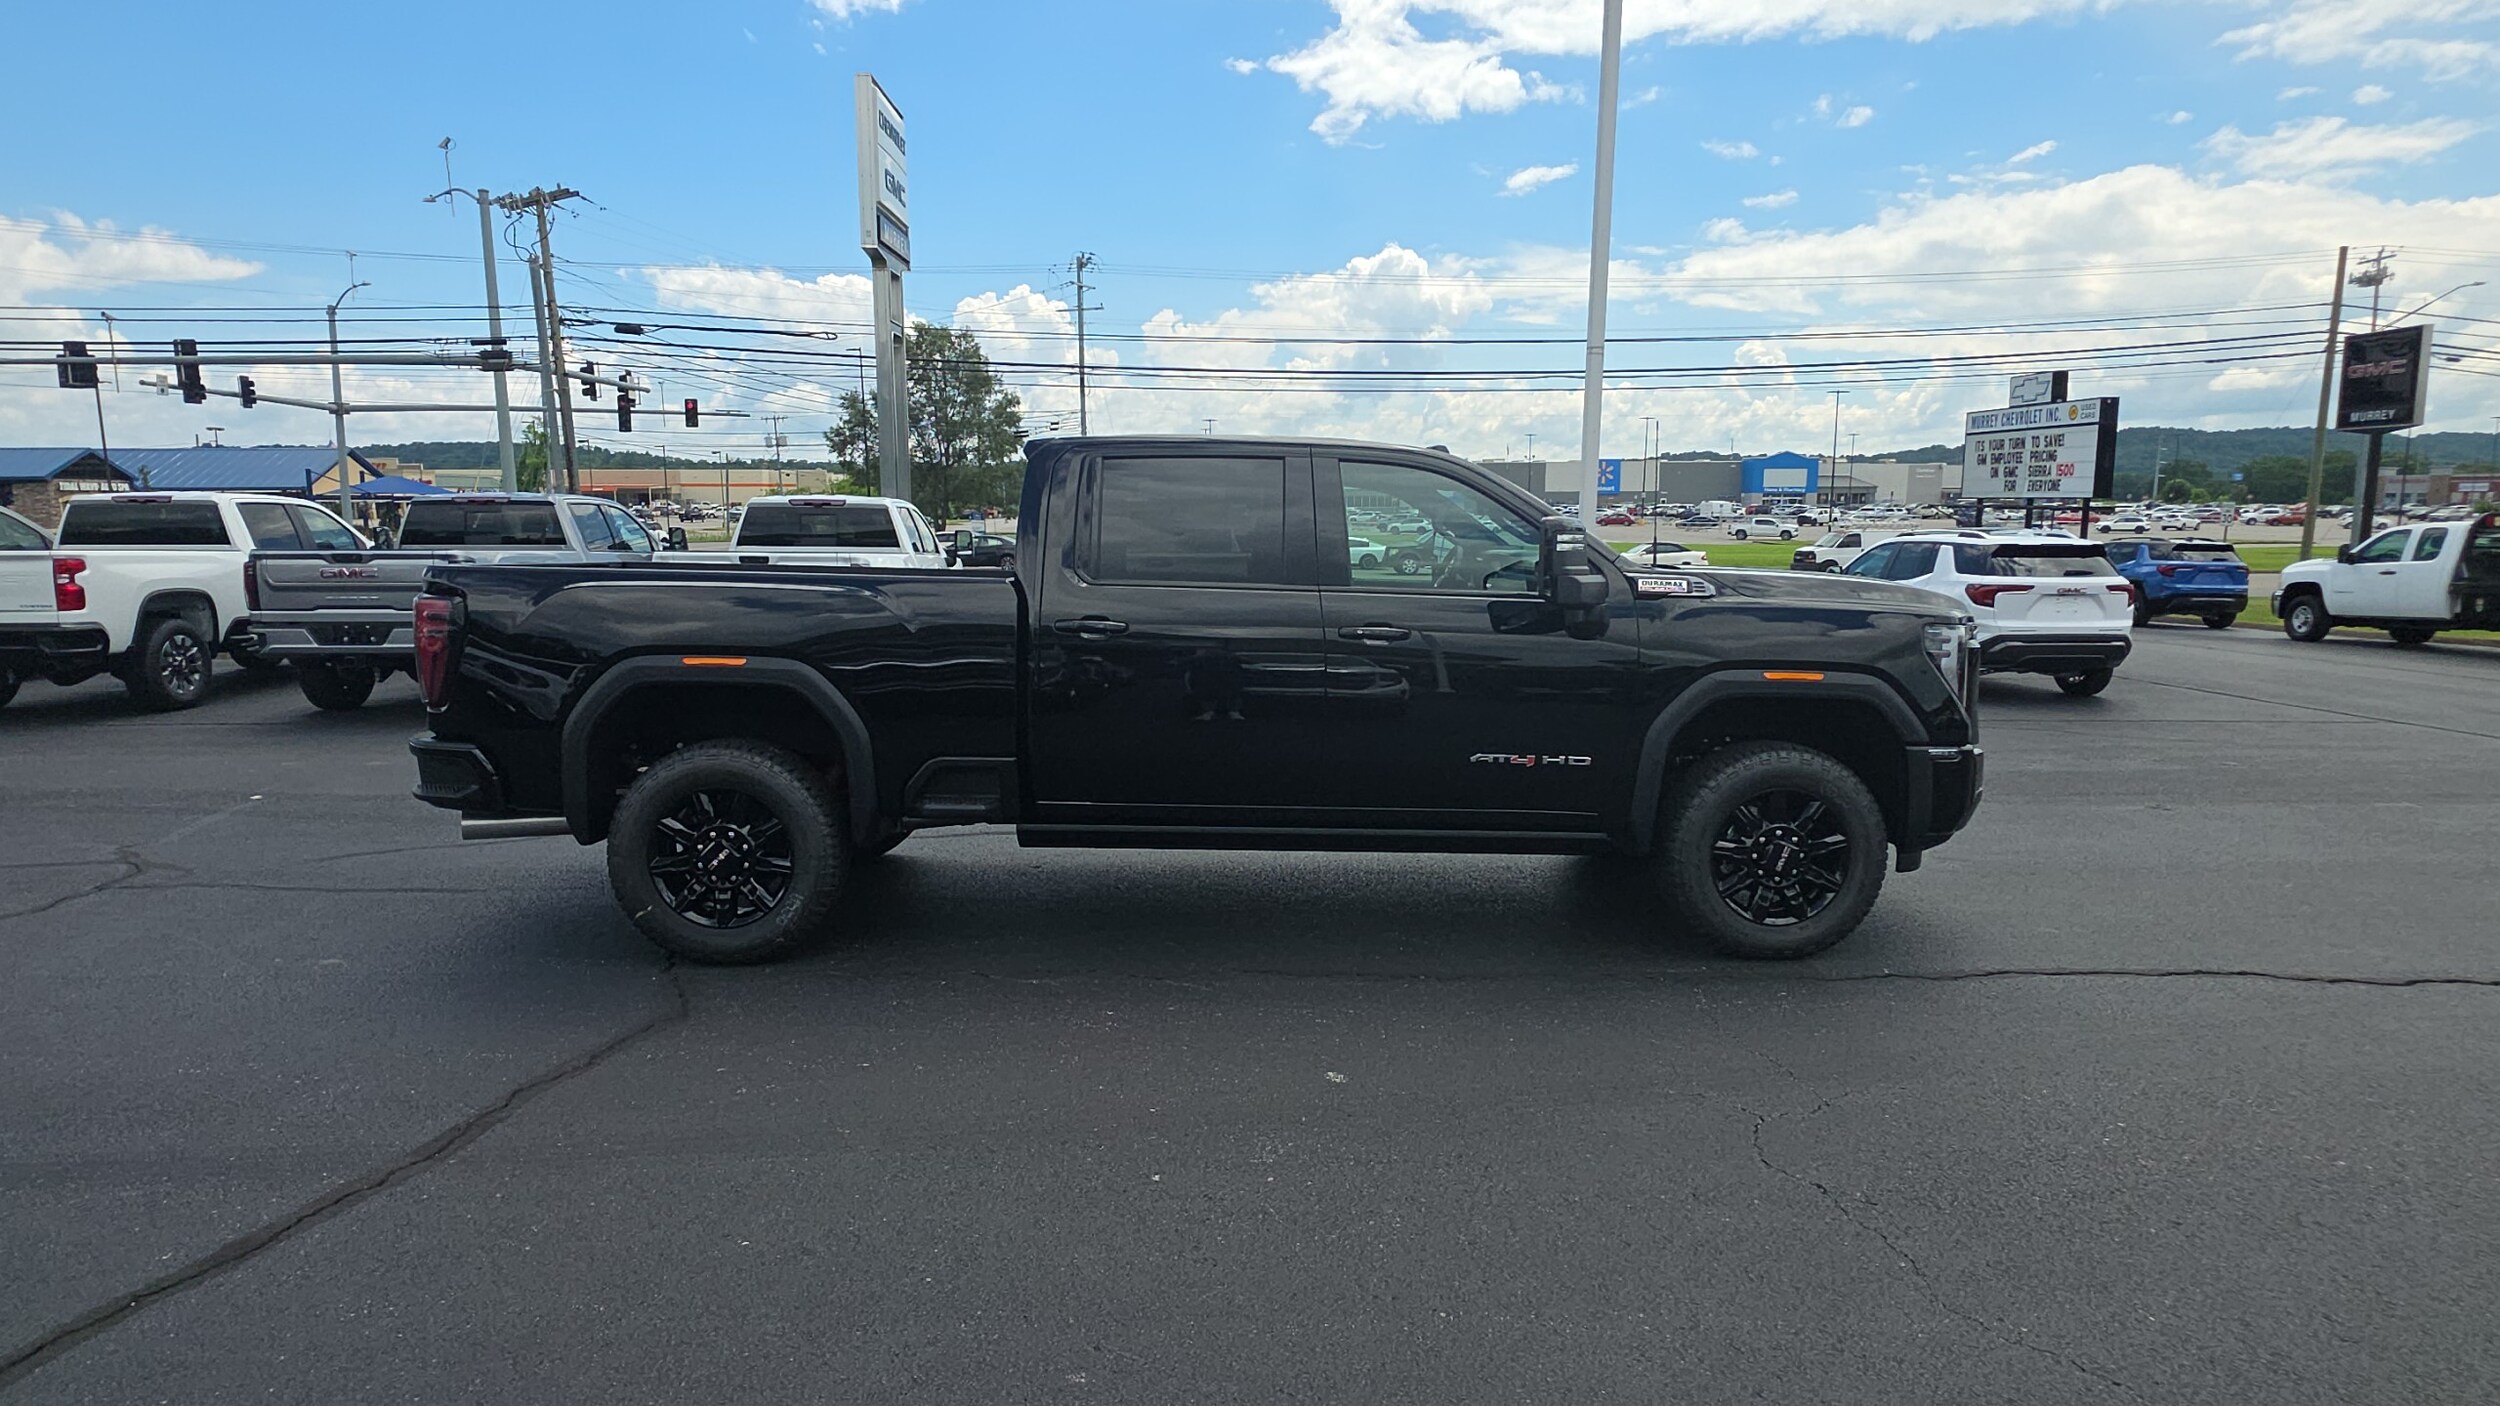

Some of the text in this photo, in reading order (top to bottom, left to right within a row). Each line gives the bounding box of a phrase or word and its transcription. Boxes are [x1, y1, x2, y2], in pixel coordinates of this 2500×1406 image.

[885, 168, 906, 208] GMC
[2347, 359, 2408, 379] GMC
[1971, 413, 1998, 430] MURREY
[2001, 409, 2043, 427] CHEVROLET
[2046, 406, 2062, 422] INC.
[2080, 410, 2096, 420] CARS
[2349, 409, 2396, 422] MURREY
[1989, 438, 2005, 451] YOUR
[2009, 437, 2026, 450] TURN
[2031, 435, 2041, 448] TO
[1977, 449, 2058, 465] GM EMPLOYEE PRICING
[1990, 463, 2075, 478] ON GMC SIERRA 1500
[2003, 478, 2061, 493] FOR EVERYONE
[320, 567, 378, 579] GMC
[1470, 753, 1592, 767] AT4 HD
